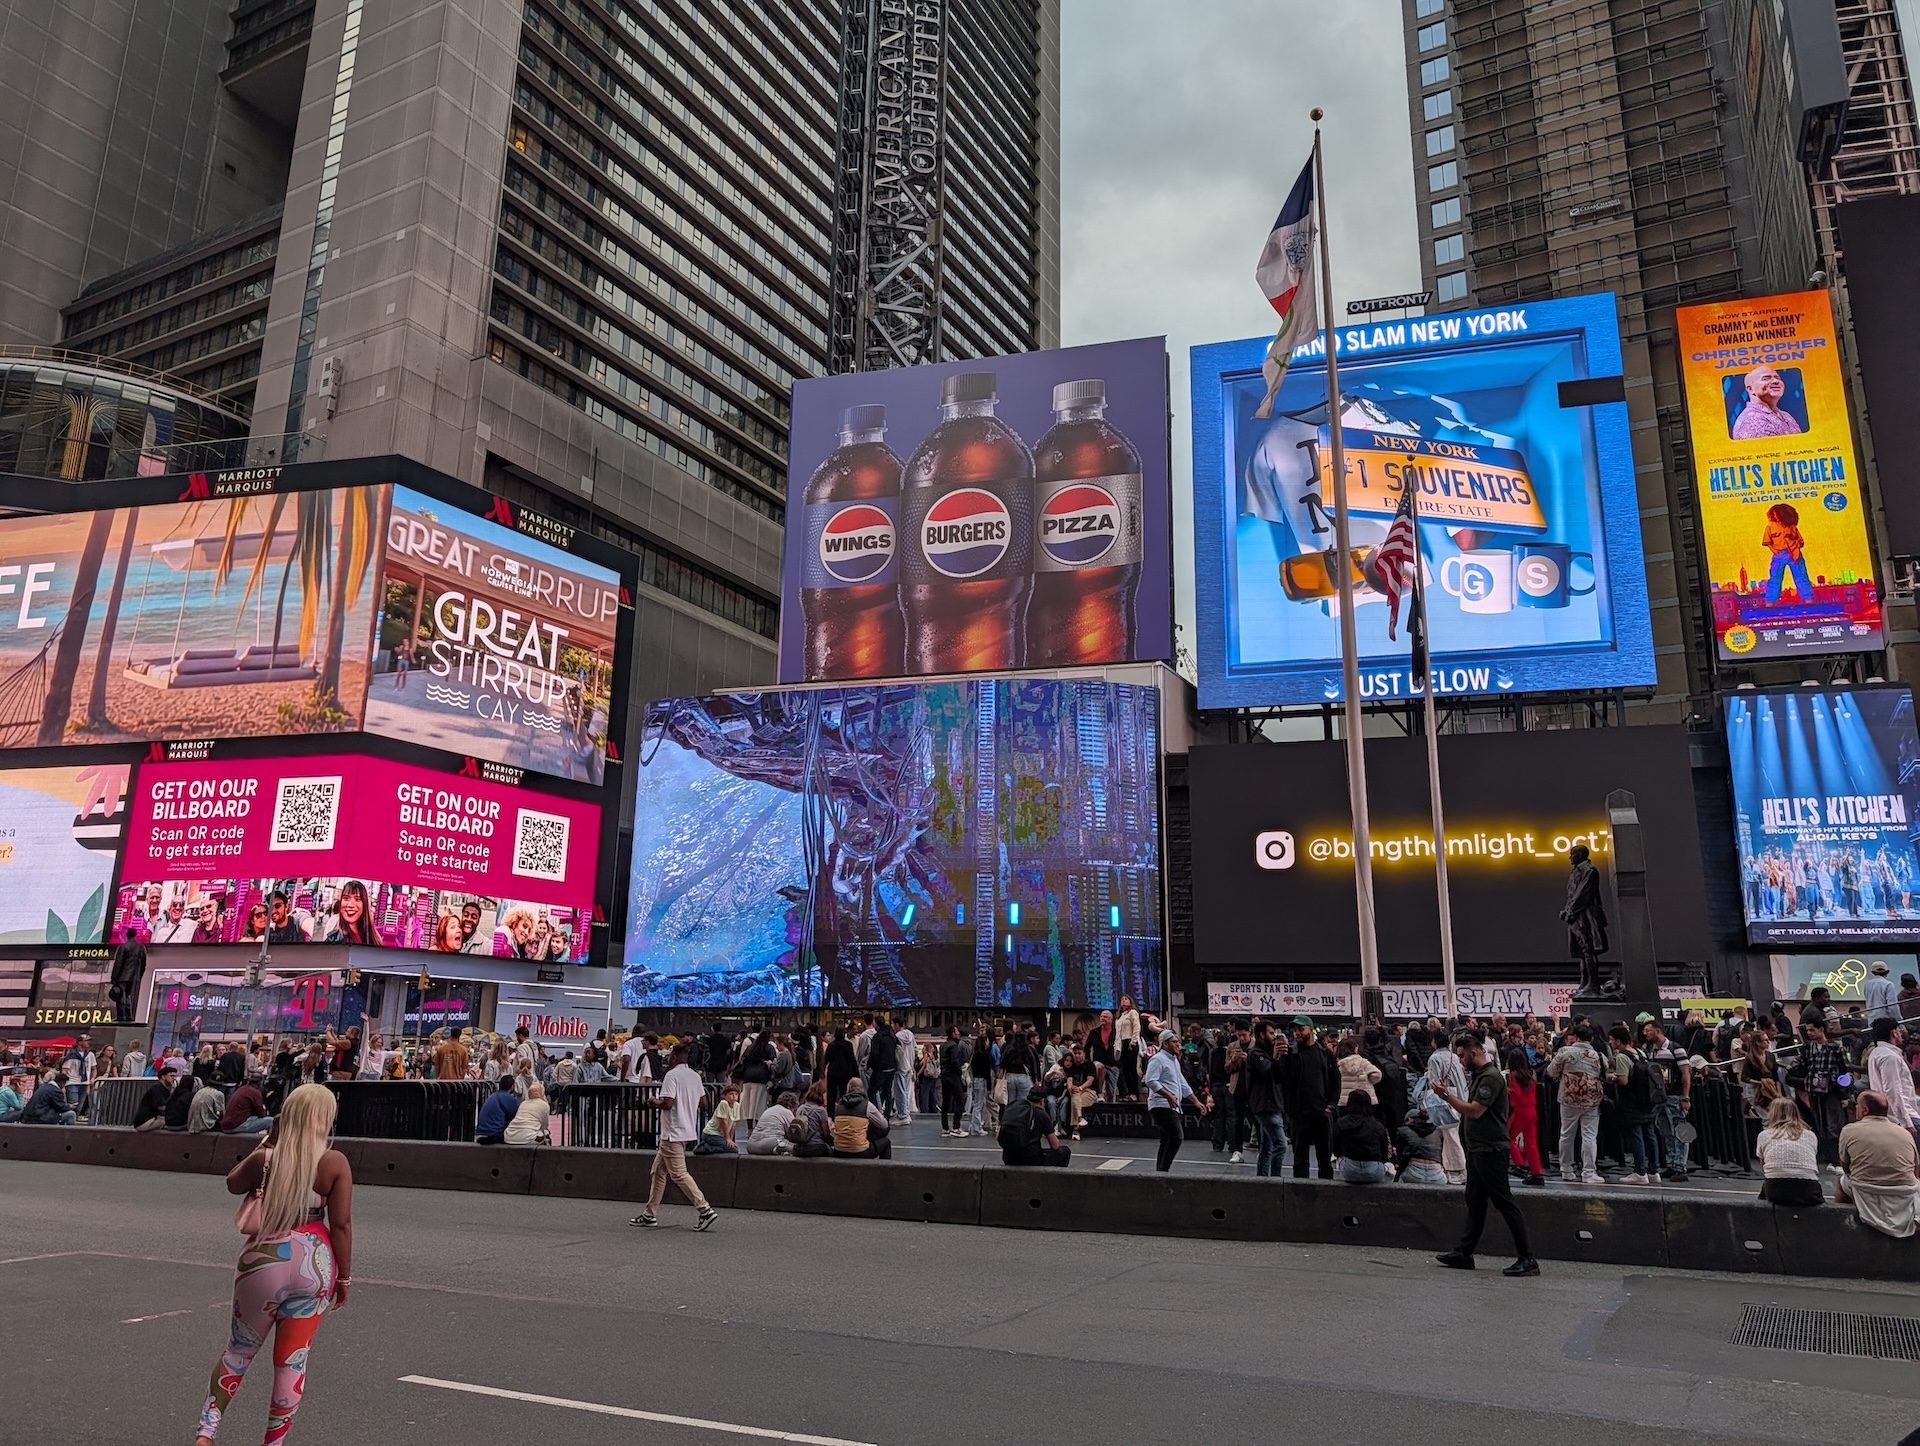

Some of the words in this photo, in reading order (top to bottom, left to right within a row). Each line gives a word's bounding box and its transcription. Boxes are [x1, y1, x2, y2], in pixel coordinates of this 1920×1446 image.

[910, 0, 941, 174] OUTFITTE
[873, 26, 907, 217] AMERICAN
[1742, 307, 1789, 317] STARRING
[1347, 324, 1405, 350] SLAM
[1412, 319, 1461, 343] NEW
[1466, 309, 1527, 334] YORK
[1752, 319, 1768, 328] AND
[1717, 332, 1753, 346] AWARD
[1755, 327, 1796, 340] WINNER
[1691, 338, 1826, 361] CHRISTOPHER
[1714, 351, 1805, 369] JACKSON
[1373, 434, 1420, 452] NEW
[1424, 440, 1479, 460] YORK
[218, 468, 282, 481] MARRIOTT
[1384, 462, 1531, 505] SOUVENIRS
[1710, 463, 1764, 492] HELL'S
[1770, 456, 1845, 487] KITCHEN
[216, 481, 272, 494] MARQUIS
[1712, 490, 1766, 499] BROADWAY'S
[1784, 485, 1820, 493] MUSICAL
[1741, 494, 1782, 504] ALICIA
[1784, 491, 1818, 500] KEYS
[1449, 503, 1494, 517] STATE
[519, 508, 576, 538] MARRIOTT
[519, 520, 569, 547] MARQUIS
[926, 520, 1006, 545] BURGERS
[1042, 514, 1115, 535] PIZZA
[388, 514, 481, 577] GREAT
[824, 533, 892, 553] WINGS
[480, 564, 539, 593] NORWEGIAN
[487, 576, 514, 591] CRUISE
[514, 584, 533, 598] LINE
[1464, 571, 1485, 595] G
[1526, 563, 1549, 589] S
[434, 591, 570, 670] GREAT
[429, 640, 567, 707] STIRRUP
[476, 695, 520, 725] CAY
[169, 750, 208, 759] MARQUIS
[170, 741, 215, 750] MARRIOTT
[483, 771, 519, 785] MARQUIS
[484, 762, 524, 777] MARRIOTT
[151, 781, 187, 800] GET
[188, 780, 216, 798] ON
[219, 778, 258, 797] OUR
[151, 799, 250, 820] BILLBOARD
[397, 783, 433, 805] GET
[435, 791, 461, 812] ON
[465, 797, 500, 820] OUR
[1762, 797, 1820, 827] HELL'S
[1826, 794, 1907, 825] KITCHEN
[399, 805, 495, 837] BILLBOARD
[9, 828, 16, 838] a
[151, 827, 183, 841] Scan
[187, 826, 207, 840] QR
[211, 825, 245, 840] code
[399, 830, 432, 848] Scan
[436, 836, 456, 851] QR
[459, 842, 490, 858] code
[1796, 833, 1839, 842] ALICIA
[1842, 832, 1878, 840] KEYS
[148, 844, 163, 857] to
[165, 845, 188, 860] get
[192, 841, 243, 856] started
[397, 847, 412, 861] to
[415, 851, 438, 866] get
[441, 855, 489, 873] started
[68, 949, 110, 958] SEPHORA
[1230, 984, 1261, 993] SPORTS
[1264, 984, 1281, 992] FAN
[1284, 984, 1305, 993] SHOP
[1456, 988, 1533, 1014] SLAM
[35, 1009, 112, 1024] SEPHORA
[536, 1014, 590, 1038] Mobile
